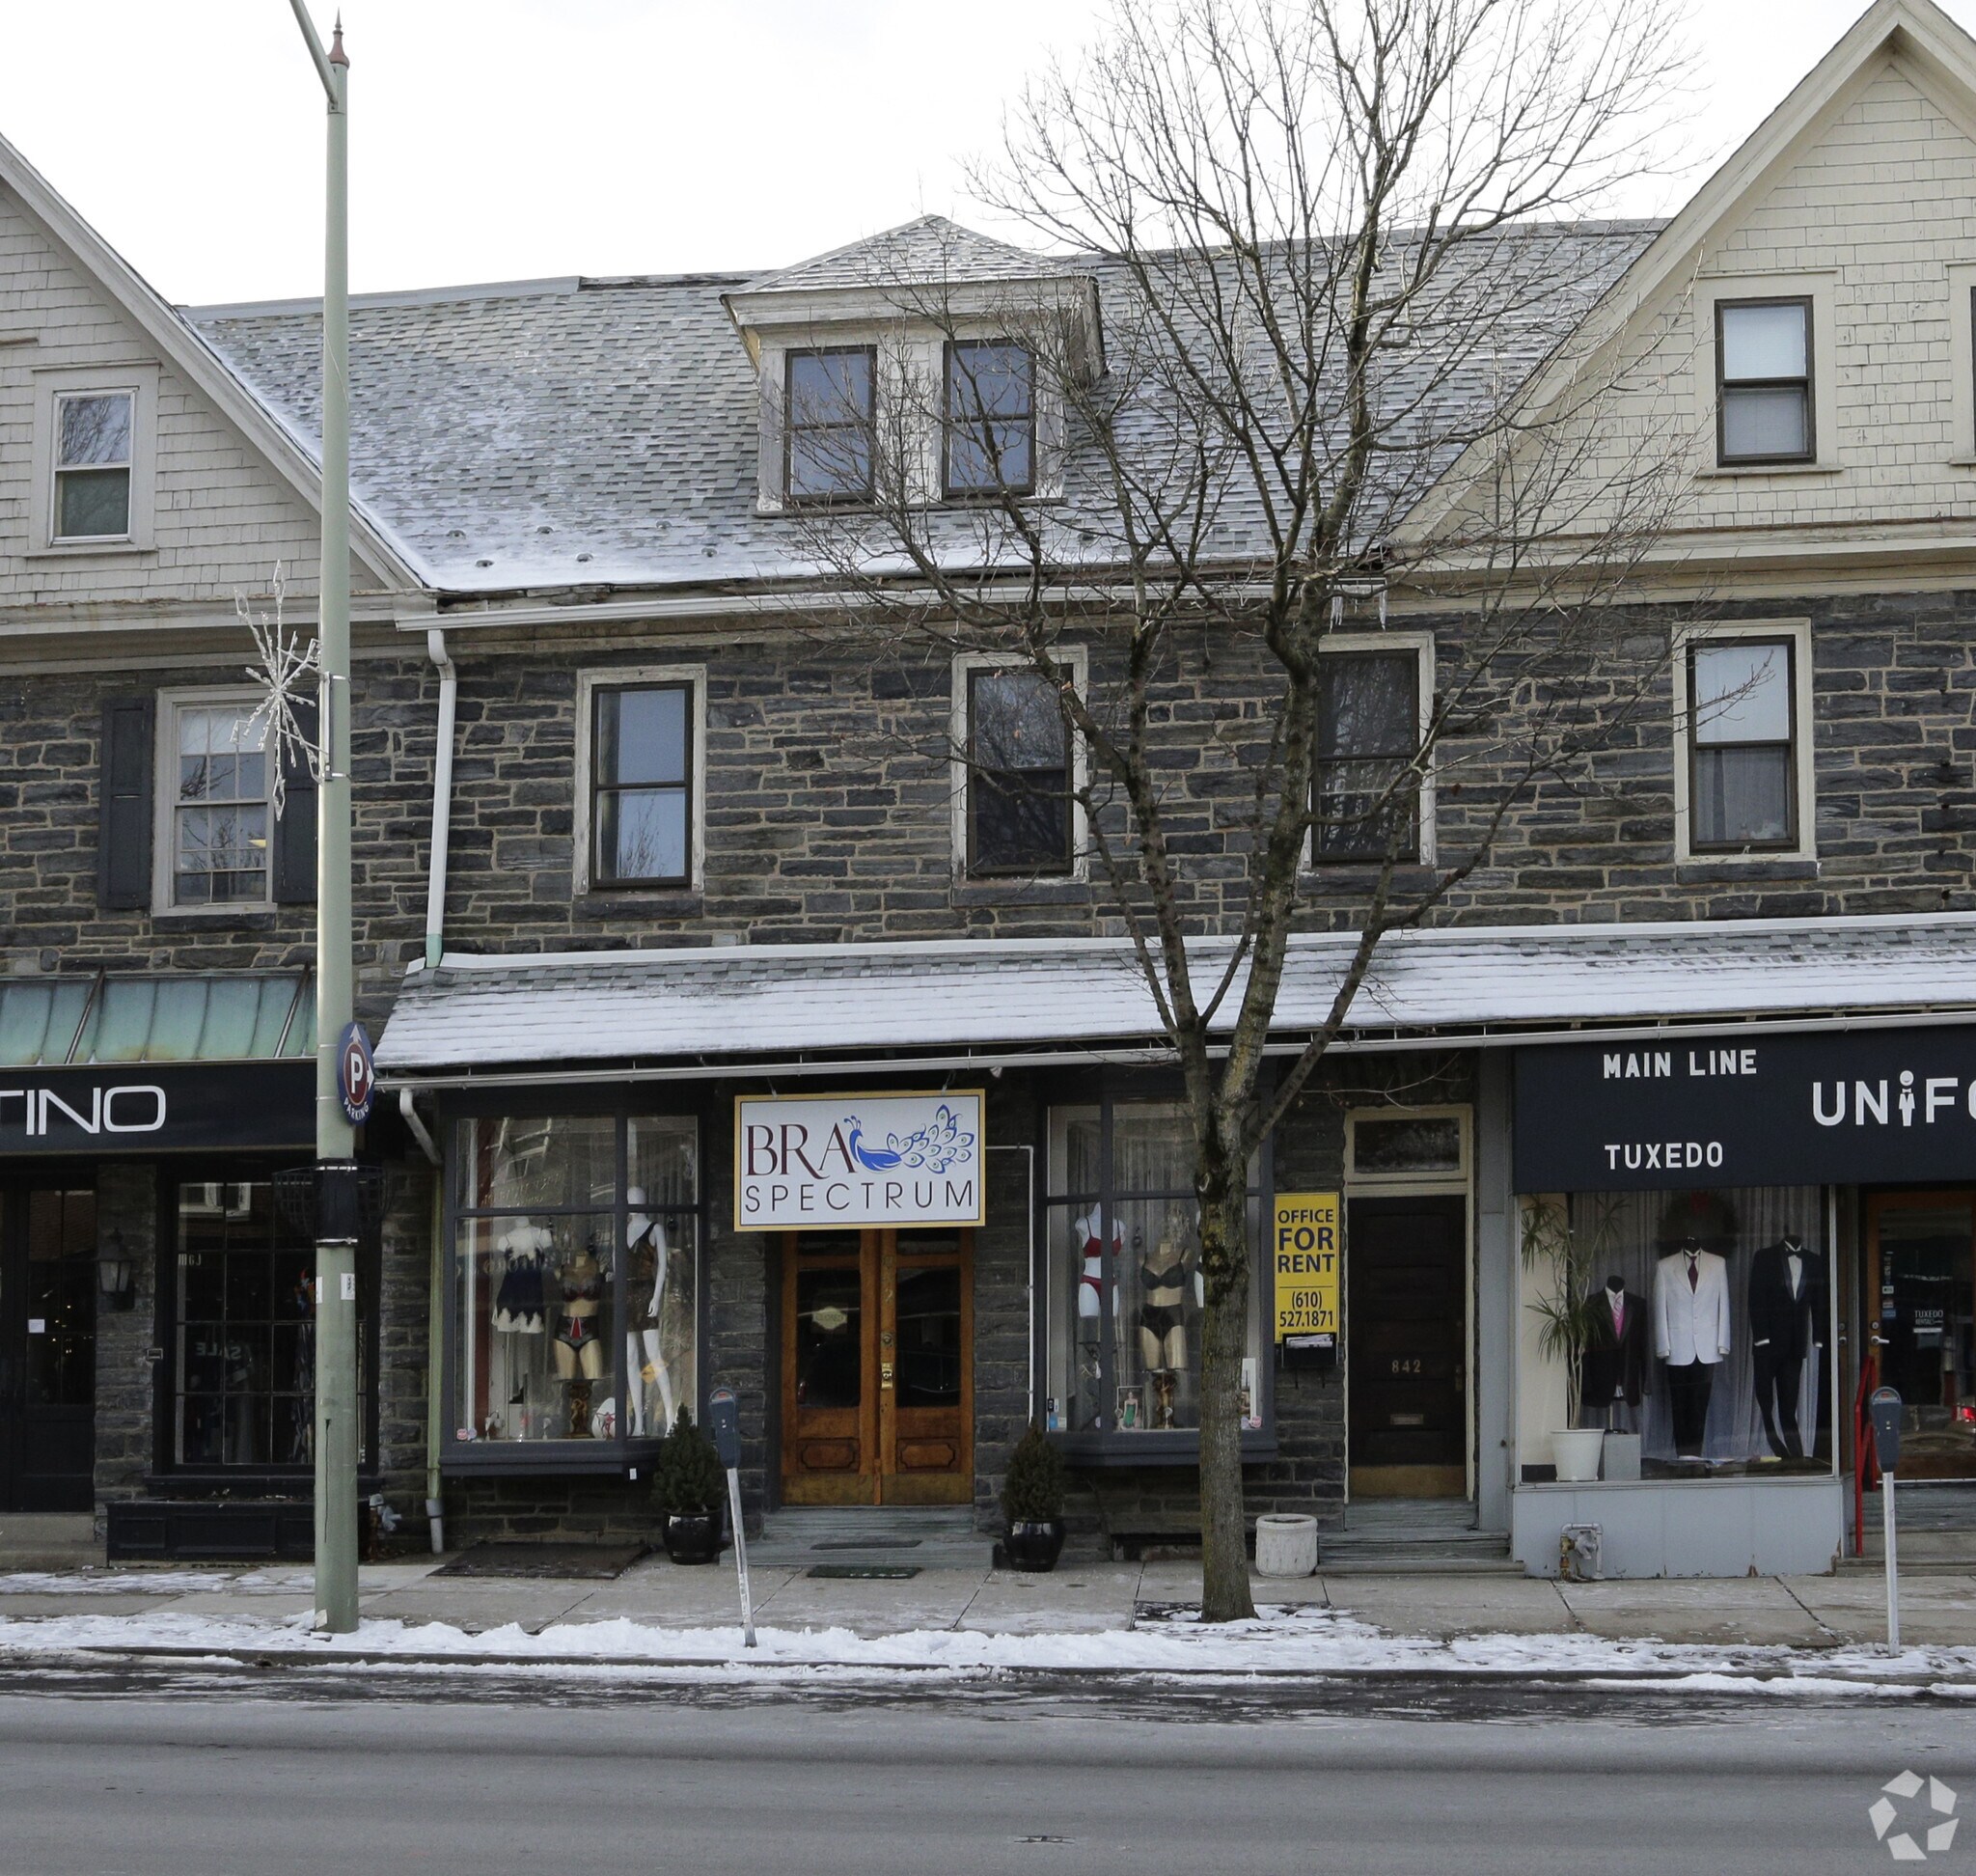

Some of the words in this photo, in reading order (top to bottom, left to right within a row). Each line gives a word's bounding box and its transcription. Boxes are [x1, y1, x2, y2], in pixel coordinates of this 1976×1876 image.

[350, 1052, 364, 1094] P
[1604, 1052, 1671, 1079] MAIN
[1689, 1049, 1757, 1076] LINE
[343, 1096, 370, 1120] PARKING
[1813, 1070, 1976, 1126] UNIF
[745, 1122, 858, 1180] BRA
[1605, 1142, 1723, 1170] TUXEDO
[745, 1179, 973, 1213] SPECTRUM
[1277, 1209, 1334, 1224] OFFICE
[1278, 1227, 1334, 1251] FOR
[1277, 1254, 1335, 1274] RENT
[1291, 1290, 1323, 1310] (610)
[1279, 1310, 1333, 1328] 527.1871
[1914, 1310, 1944, 1318] TUXEDO
[1391, 1359, 1421, 1373] 842
